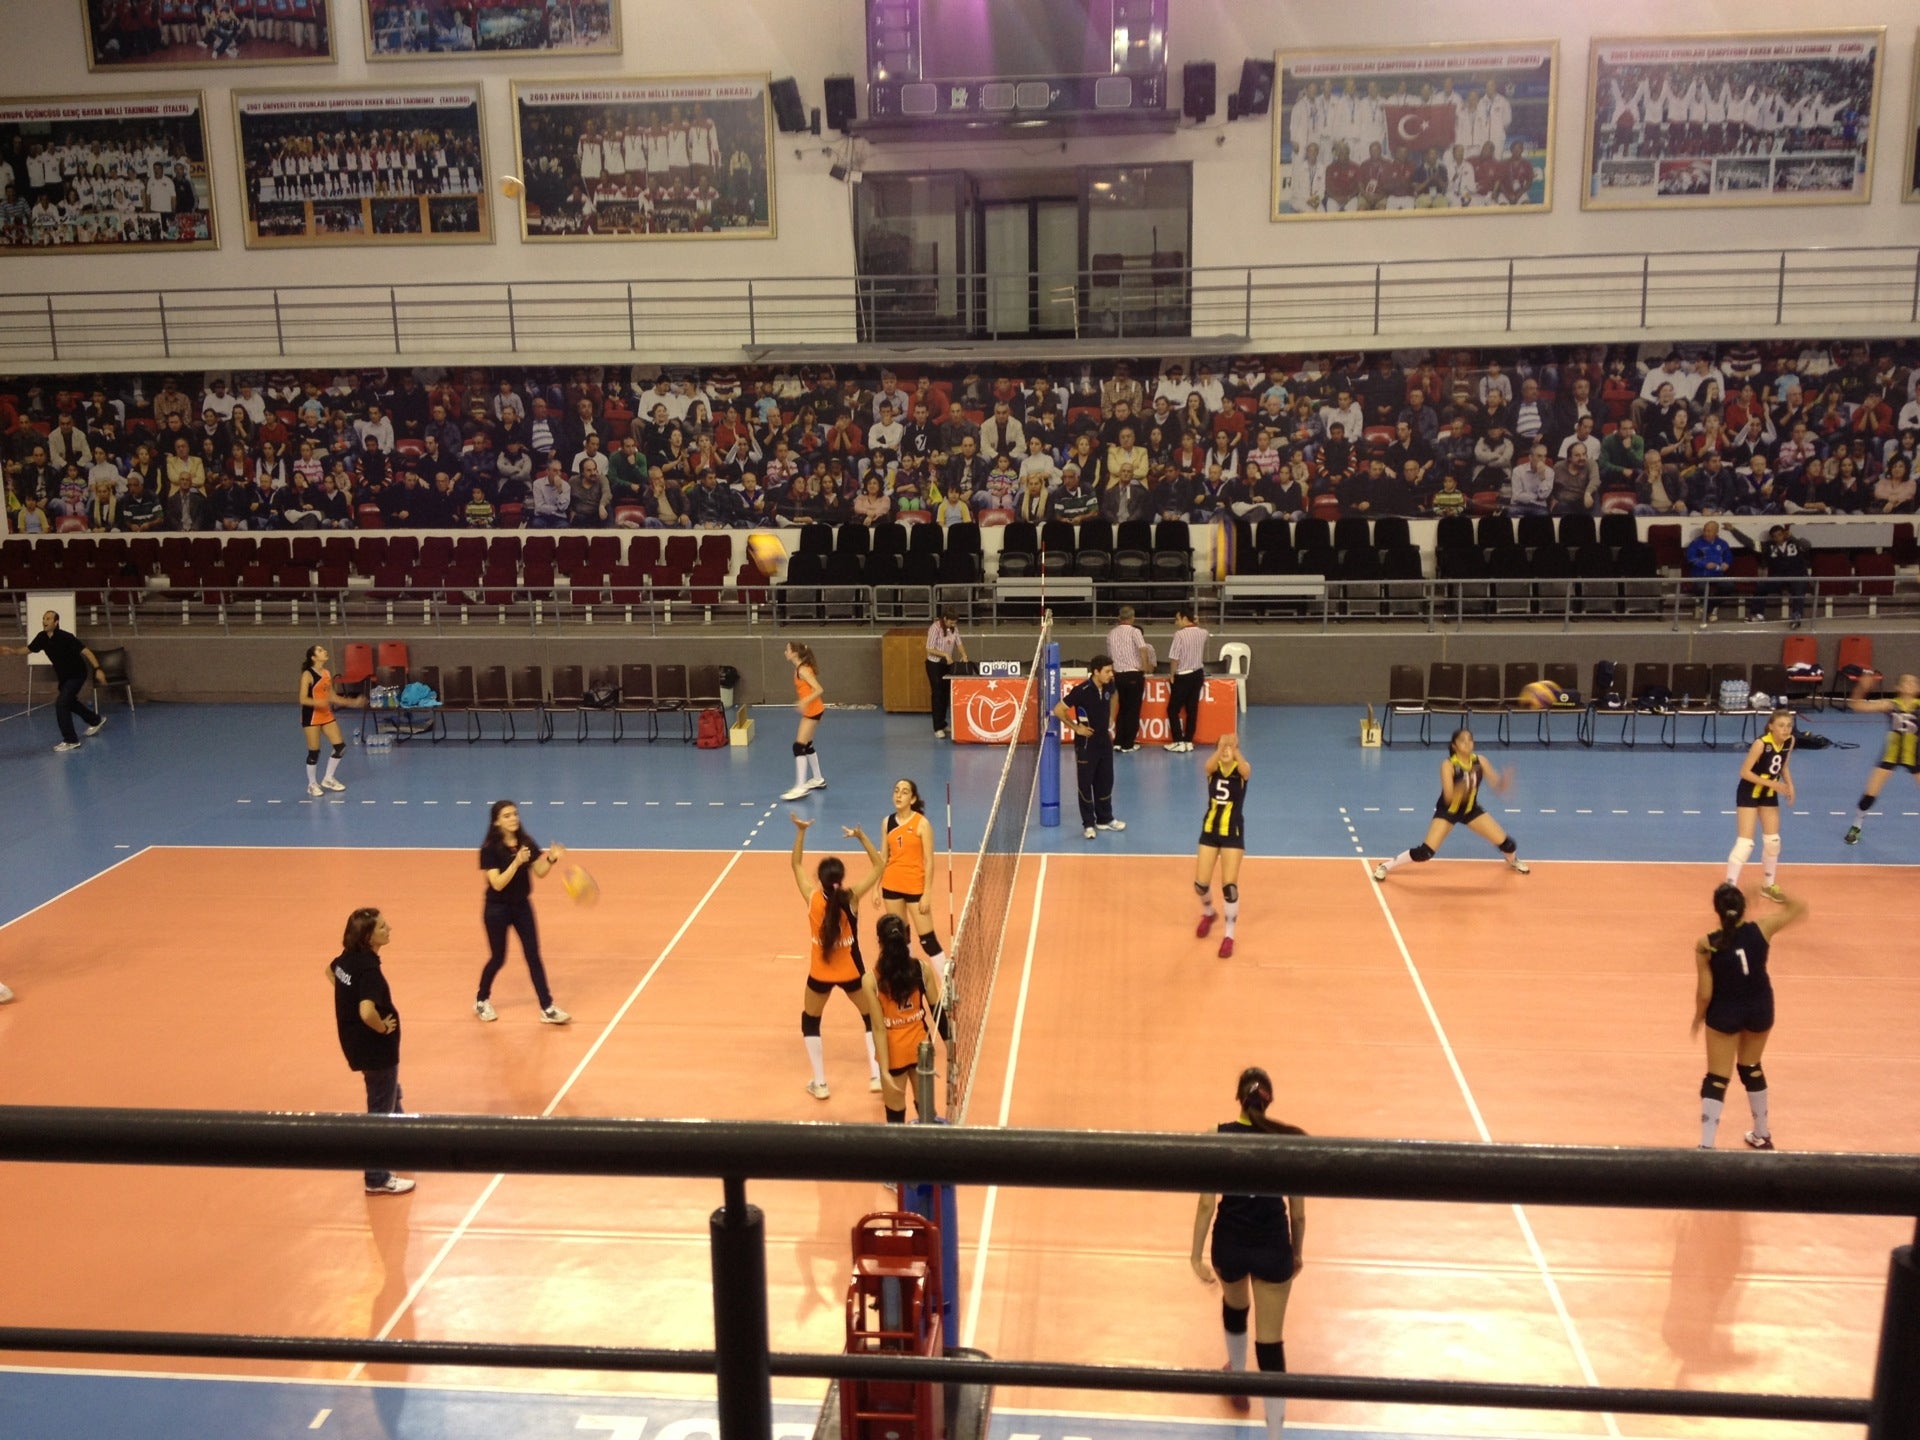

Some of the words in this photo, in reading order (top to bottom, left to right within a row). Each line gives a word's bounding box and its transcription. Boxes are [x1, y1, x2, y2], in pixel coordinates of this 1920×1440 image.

[550, 92, 580, 101] AVRUPA
[1769, 754, 1782, 775] 8
[1215, 779, 1230, 801] 5
[896, 835, 903, 849] 1
[1735, 948, 1750, 976] 1
